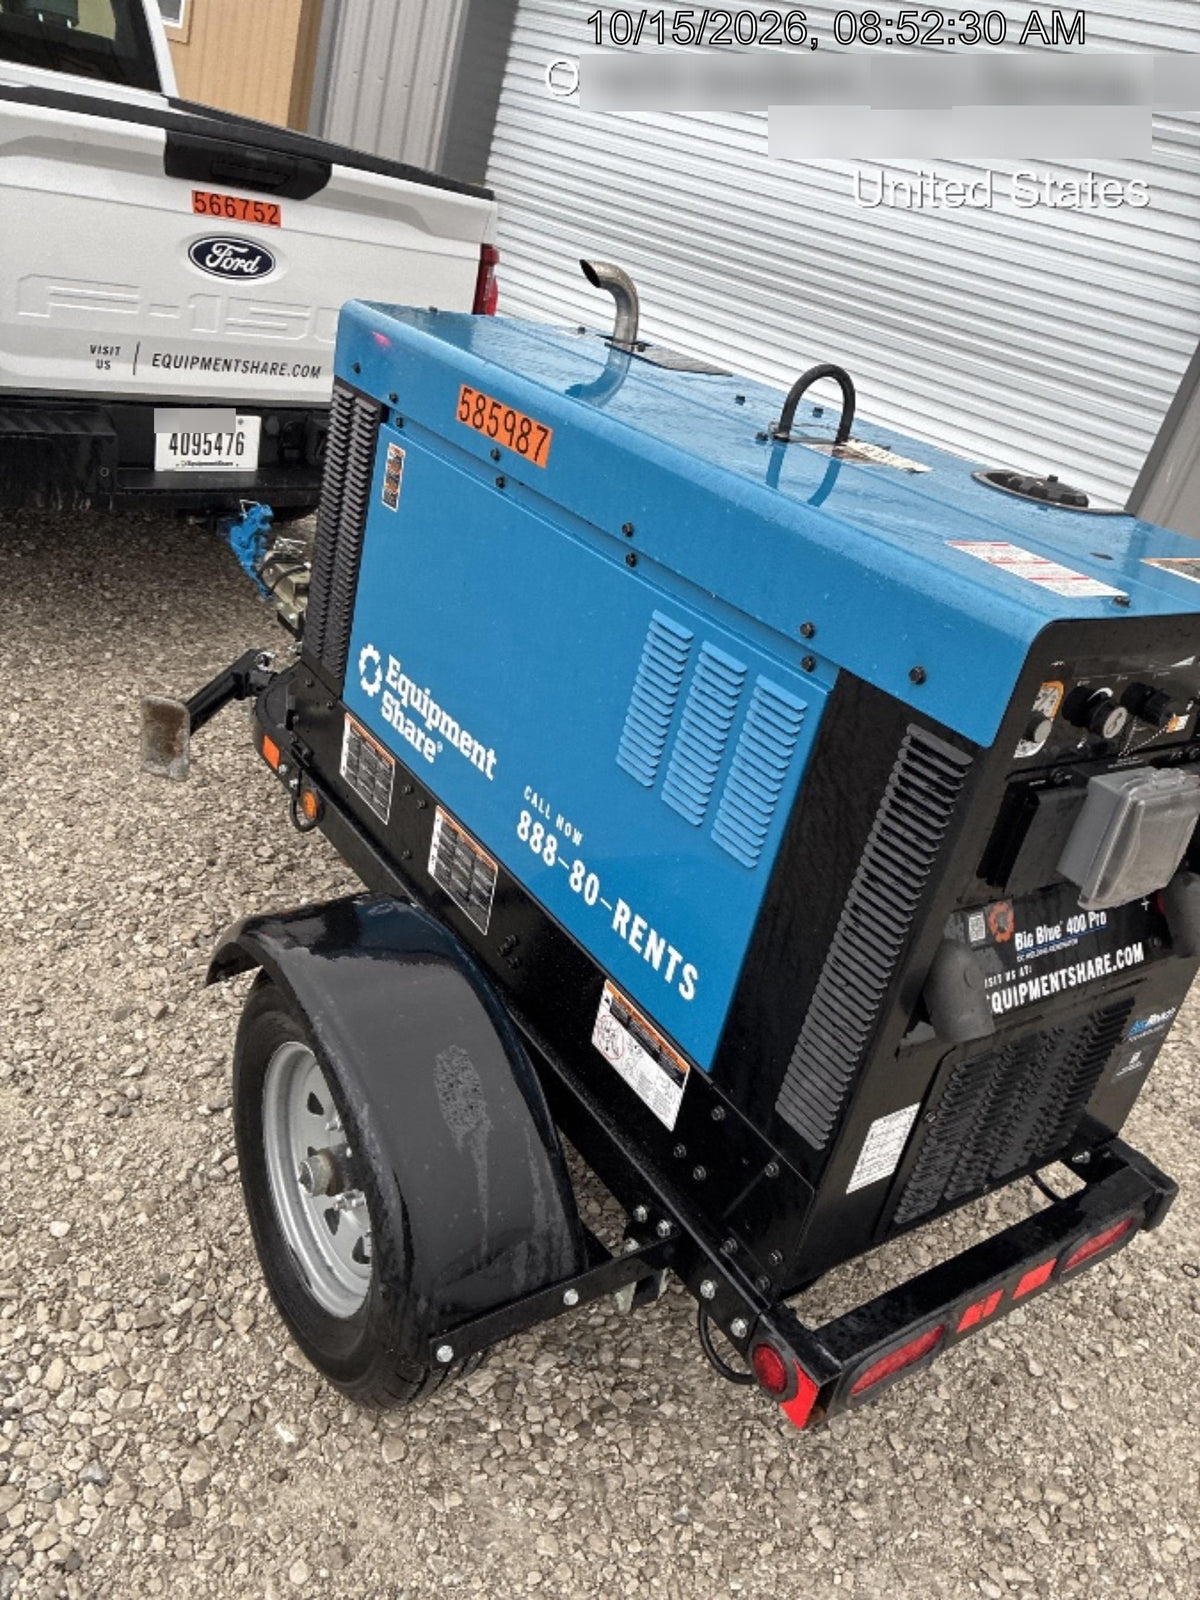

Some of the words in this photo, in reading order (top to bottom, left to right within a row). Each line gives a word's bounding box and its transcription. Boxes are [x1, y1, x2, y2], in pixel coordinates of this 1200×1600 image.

[193, 191, 280, 225] 566752
[203, 241, 260, 275] Ford
[16, 273, 337, 345] F-15
[89, 343, 122, 358] VISIT
[95, 358, 112, 371] US
[151, 352, 322, 380] EQUIPMENTSHARE.COM
[168, 431, 245, 456] 4095476
[457, 386, 550, 463] 585987
[384, 653, 499, 781] Equipment
[523, 784, 552, 821] CALL
[556, 812, 585, 847] NOW
[516, 809, 700, 1002] 888-80-RENTS
[1014, 930, 1035, 952] Big
[1066, 912, 1087, 935] 400
[1088, 911, 1108, 929] Pro
[985, 941, 1145, 1014] QUIPMENTSHARE.COM
